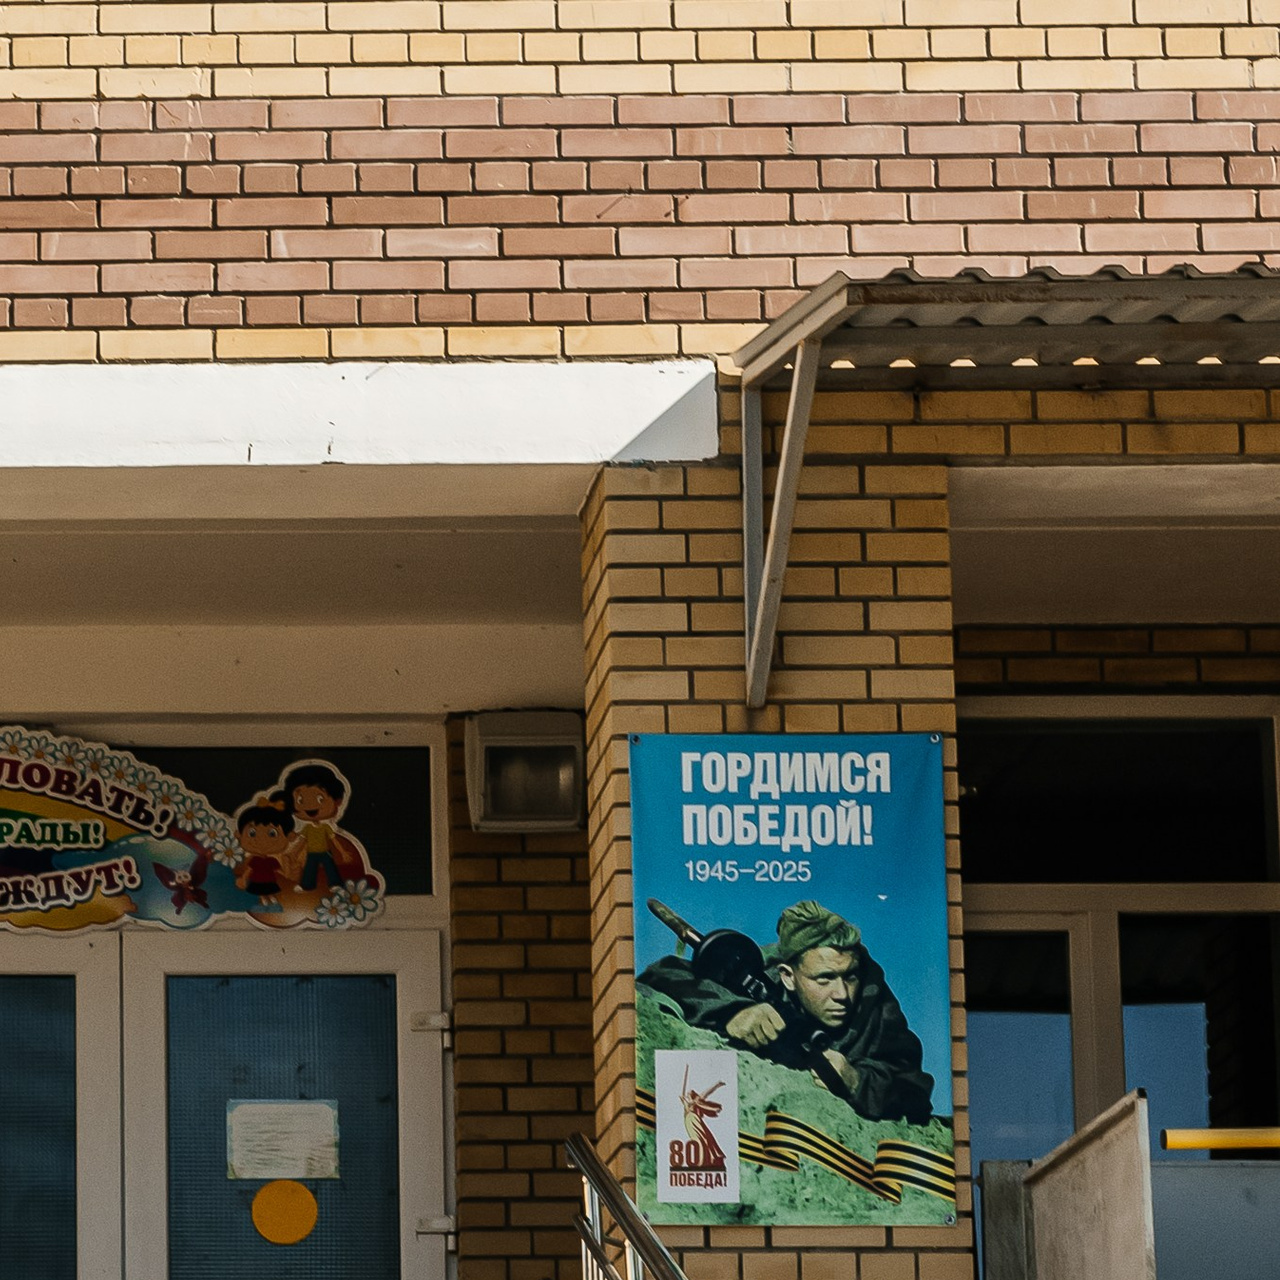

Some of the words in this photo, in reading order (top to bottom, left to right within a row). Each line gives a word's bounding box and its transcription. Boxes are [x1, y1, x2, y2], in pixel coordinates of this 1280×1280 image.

[681, 752, 891, 800] ГОРДИМСЯ
[682, 800, 874, 852] ПОБЕДОЙ!
[669, 1139, 701, 1167] 80
[669, 1172, 728, 1189] ПОБЕДА!
